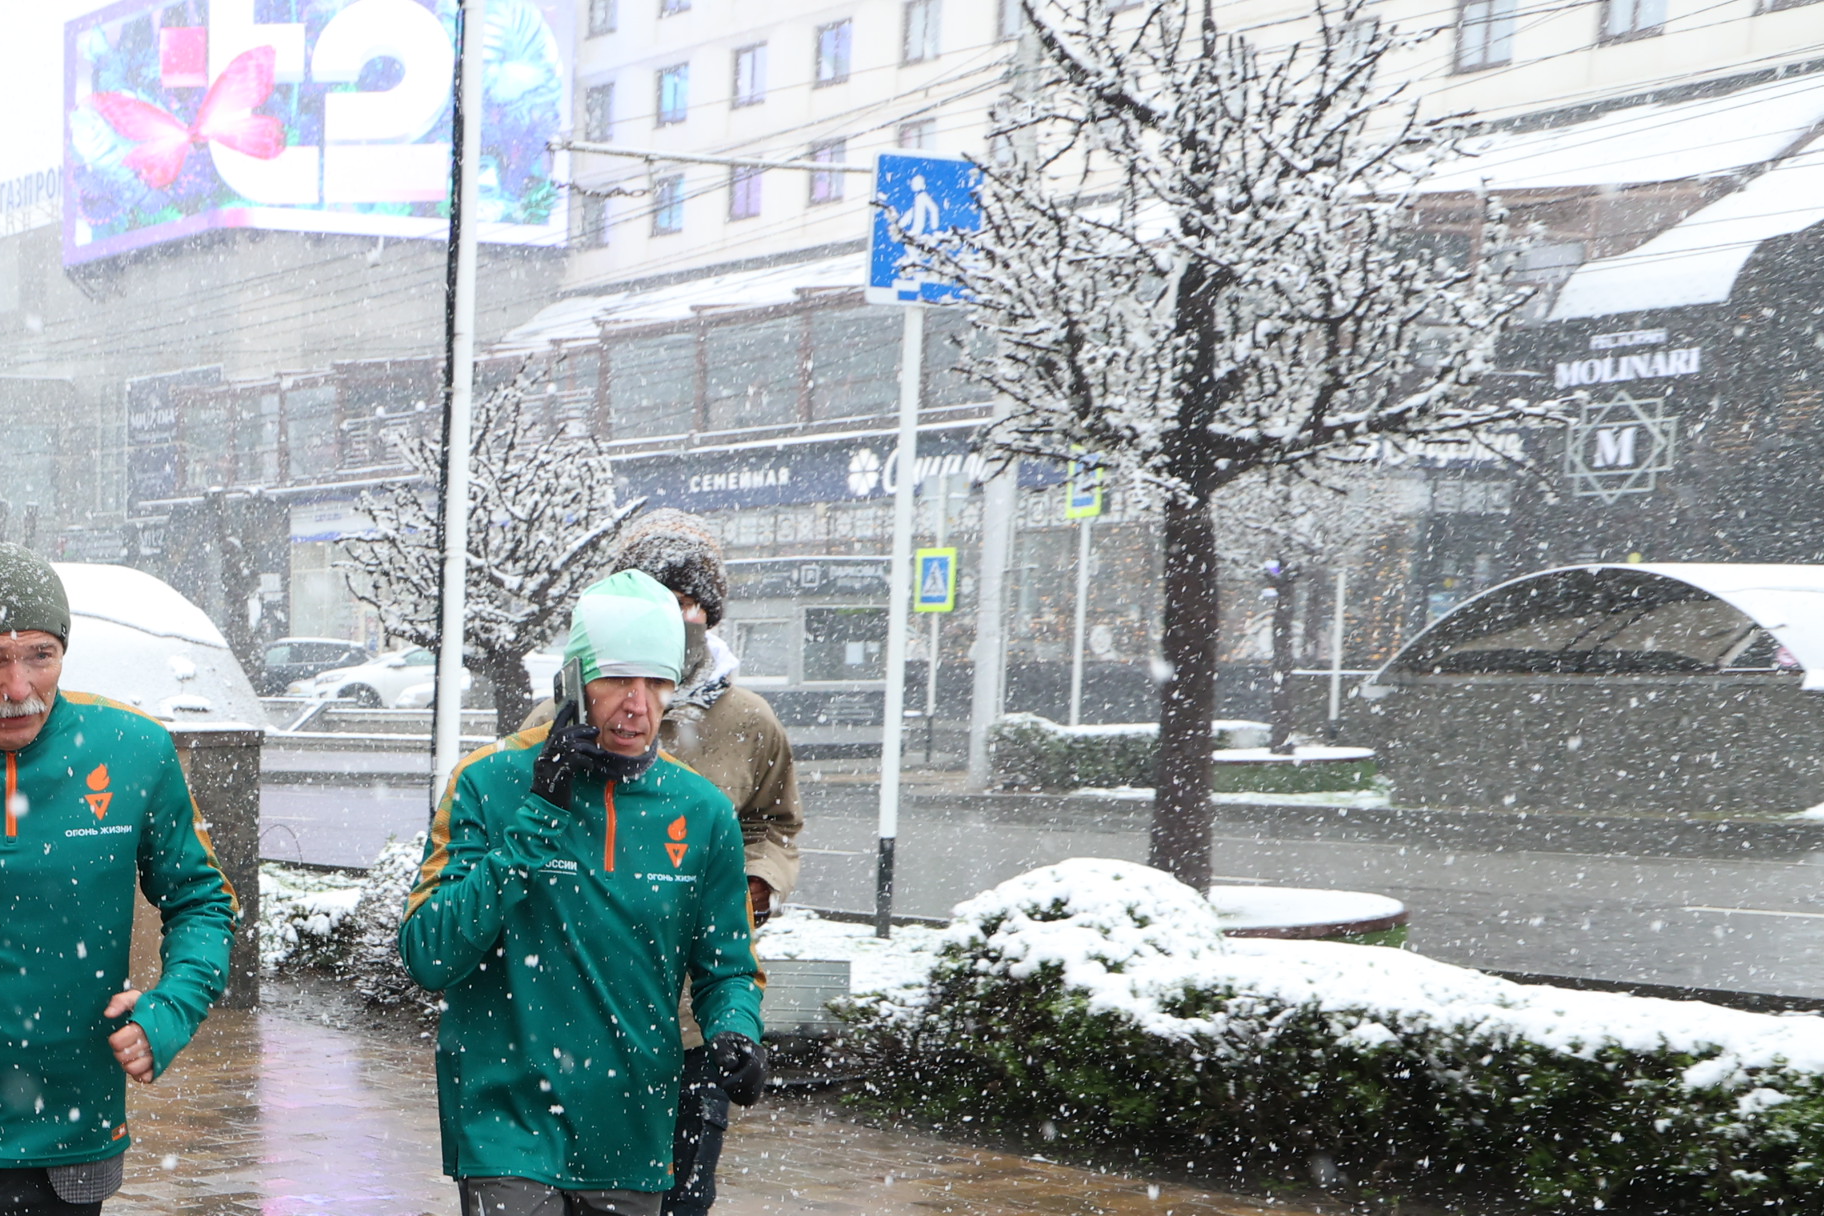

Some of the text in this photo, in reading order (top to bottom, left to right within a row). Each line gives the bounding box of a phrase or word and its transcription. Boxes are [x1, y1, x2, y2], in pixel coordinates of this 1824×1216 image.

[1554, 347, 1702, 391] MOLINARI
[1593, 427, 1638, 468] M
[689, 466, 790, 494] СЕМЕЙНАЯ
[65, 825, 133, 838] ОГОНЬ ЖИЗНИ
[545, 859, 578, 871] ОССИИ
[647, 873, 674, 882] ОГОНЬ
